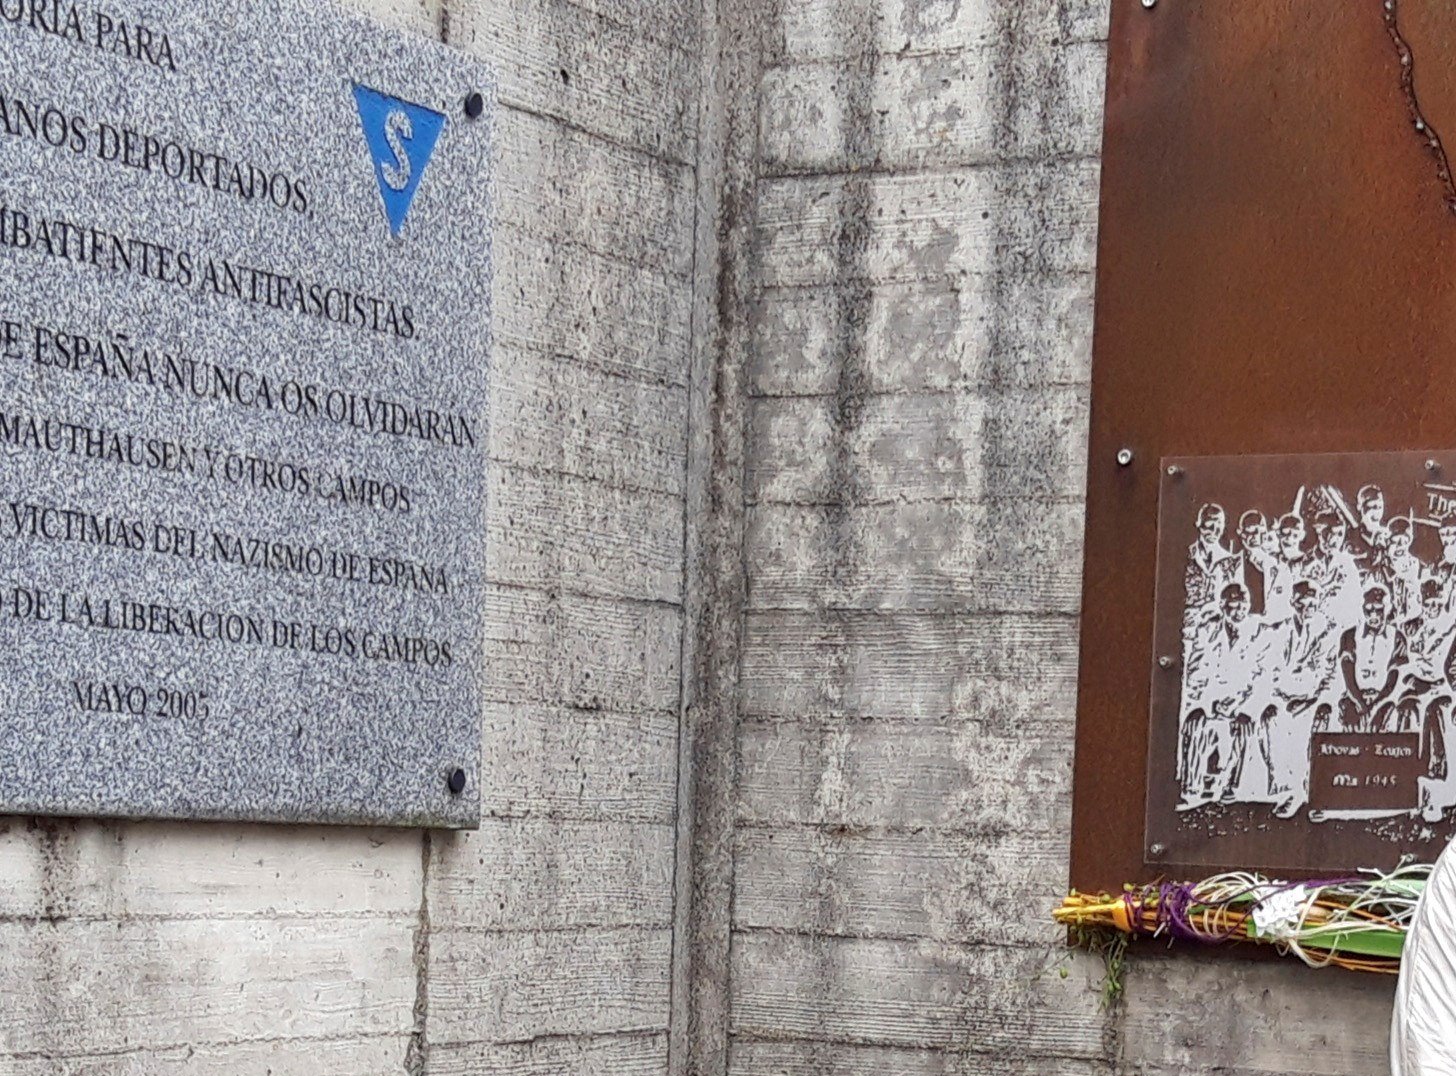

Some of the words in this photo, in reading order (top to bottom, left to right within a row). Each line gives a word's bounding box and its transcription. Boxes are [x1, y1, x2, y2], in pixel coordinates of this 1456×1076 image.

[95, 12, 176, 72] PARA
[98, 122, 314, 221] DEPORTADOS,
[380, 108, 413, 192] S
[34, 326, 155, 386] ESPAÑA
[163, 352, 273, 410] NUNCA
[280, 380, 318, 419] OS
[0, 412, 197, 473] MAUTHAUSEN
[203, 445, 220, 478] Y
[225, 453, 310, 495] OTROS
[315, 471, 410, 513] CAMPOS
[9, 502, 146, 551] VICTIMAS
[211, 532, 323, 577] NAZISMO
[331, 551, 361, 582] DE
[12, 587, 51, 621] DE
[60, 592, 95, 626] LA
[102, 599, 263, 645] LIBERACION
[272, 620, 303, 650] DE
[310, 624, 356, 657] LOS
[361, 632, 452, 668] CAMPOS
[72, 680, 148, 716] MAYO
[155, 687, 209, 722] 2005
